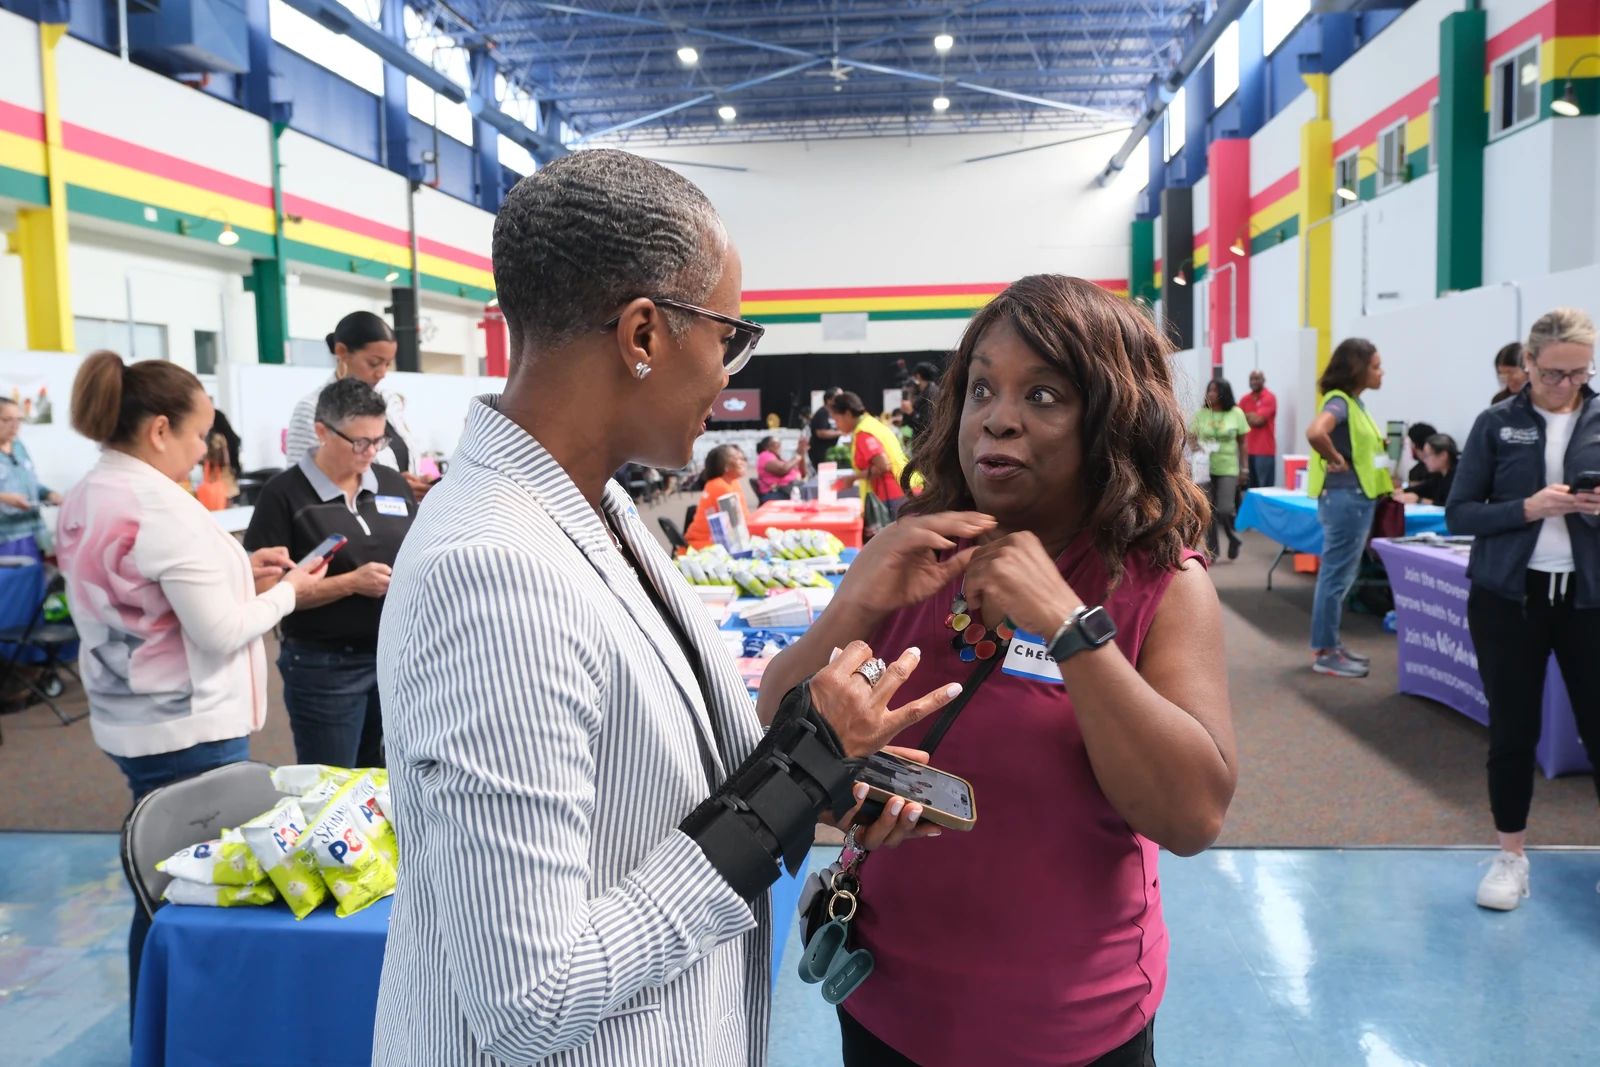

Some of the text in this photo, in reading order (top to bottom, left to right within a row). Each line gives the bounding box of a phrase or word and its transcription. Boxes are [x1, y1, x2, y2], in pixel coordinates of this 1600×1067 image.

[1404, 566, 1420, 583] Join
[1421, 571, 1435, 589] the
[1421, 598, 1447, 621] health
[1447, 607, 1461, 627] for
[1405, 626, 1421, 643] Join
[1421, 632, 1437, 651] the
